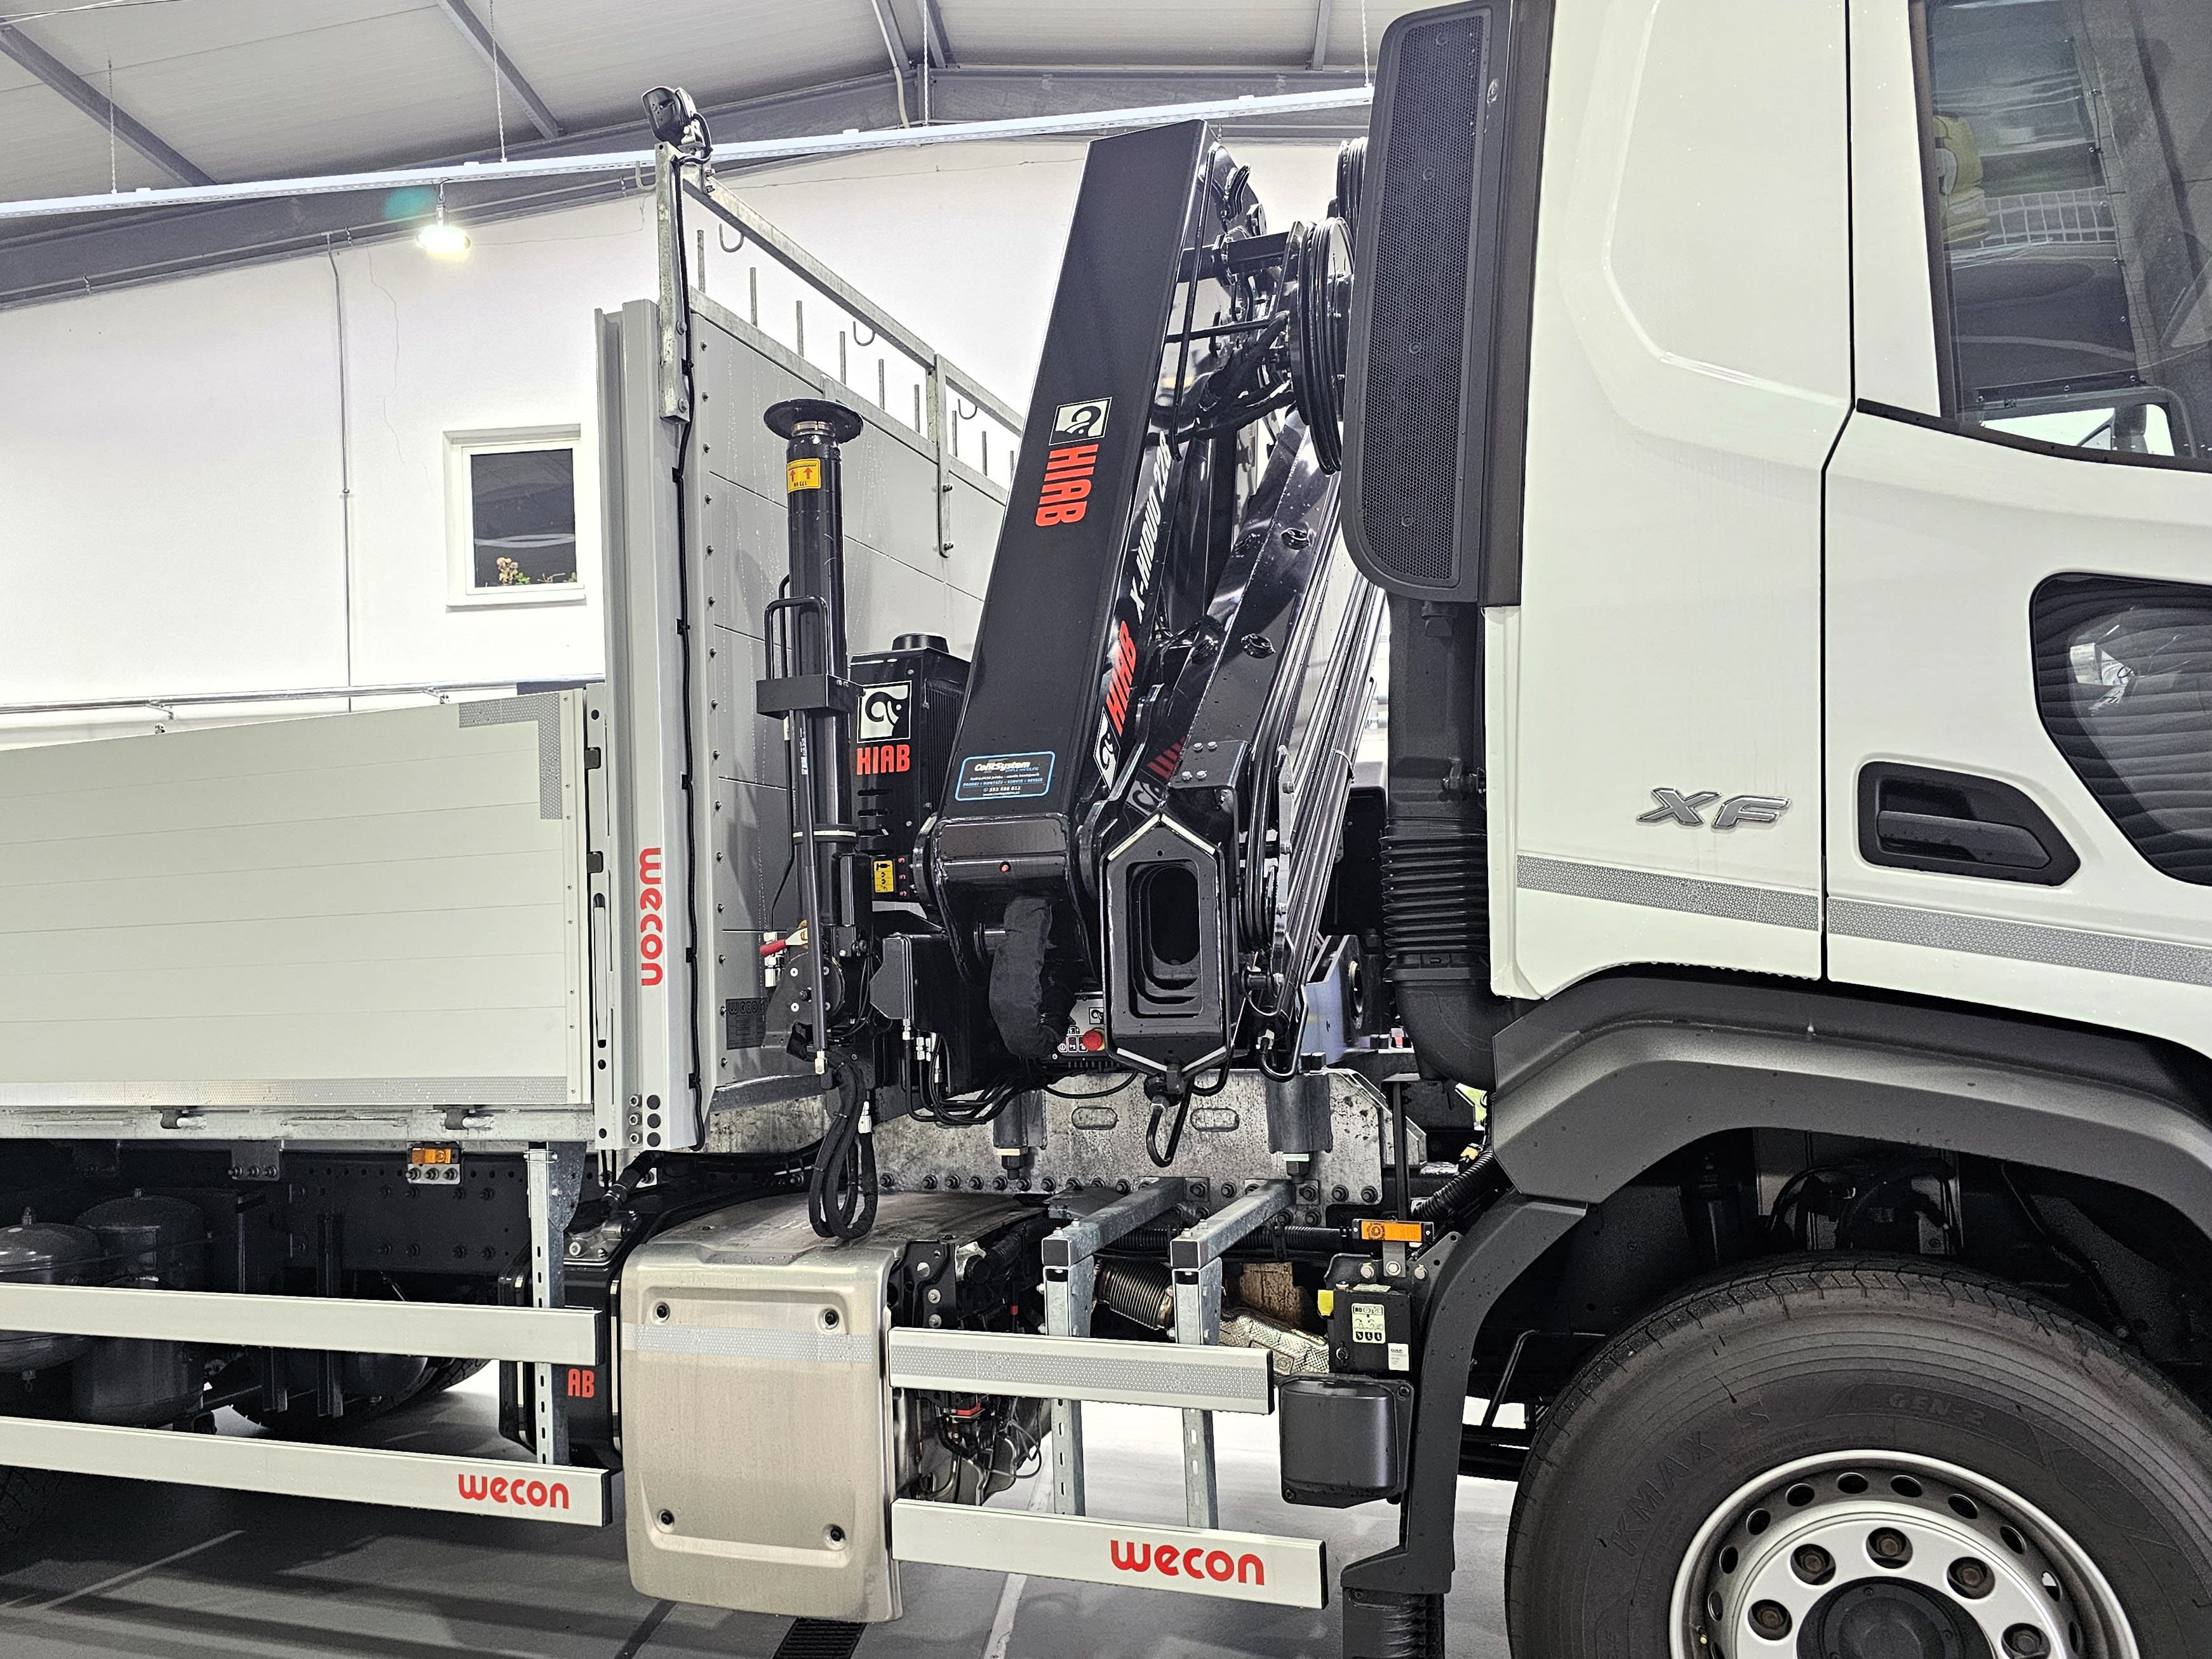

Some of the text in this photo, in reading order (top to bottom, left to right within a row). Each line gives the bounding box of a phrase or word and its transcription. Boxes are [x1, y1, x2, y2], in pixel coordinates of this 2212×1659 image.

[1035, 444, 1099, 527] HIAB
[1106, 620, 1137, 737] HIAB
[856, 744, 910, 776] HIAB
[974, 761, 1031, 772] ContSystem
[1637, 787, 1790, 829] XF
[640, 847, 663, 986] wecon
[568, 1368, 594, 1398] AB
[458, 1473, 570, 1510] wecon
[1110, 1539, 1265, 1586] wecon
